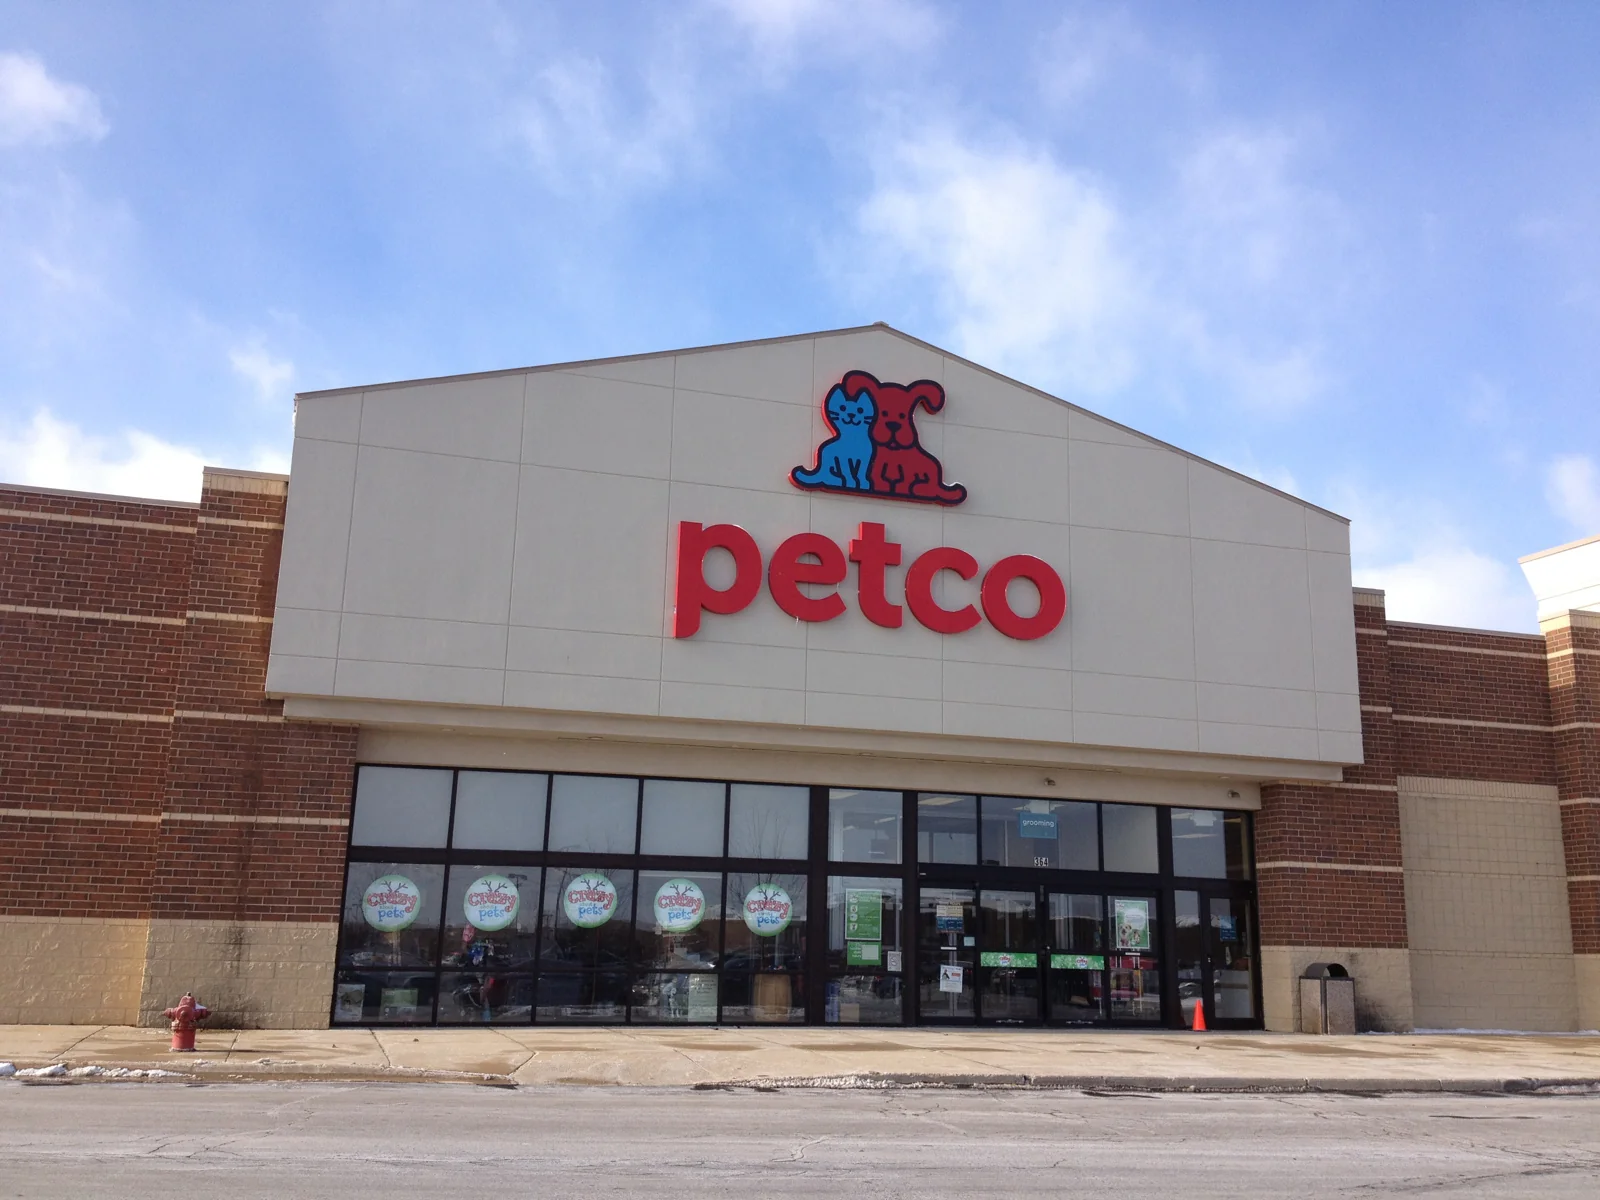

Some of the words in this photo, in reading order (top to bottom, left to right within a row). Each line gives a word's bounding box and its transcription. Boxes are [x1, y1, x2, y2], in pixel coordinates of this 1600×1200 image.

[674, 521, 1066, 640] petco
[1022, 819, 1055, 828] grooming
[1033, 856, 1049, 867] 364
[378, 906, 405, 922] pets
[479, 905, 505, 921] pets
[578, 903, 603, 919] pets
[668, 909, 692, 923] pets
[756, 911, 780, 927] pets
